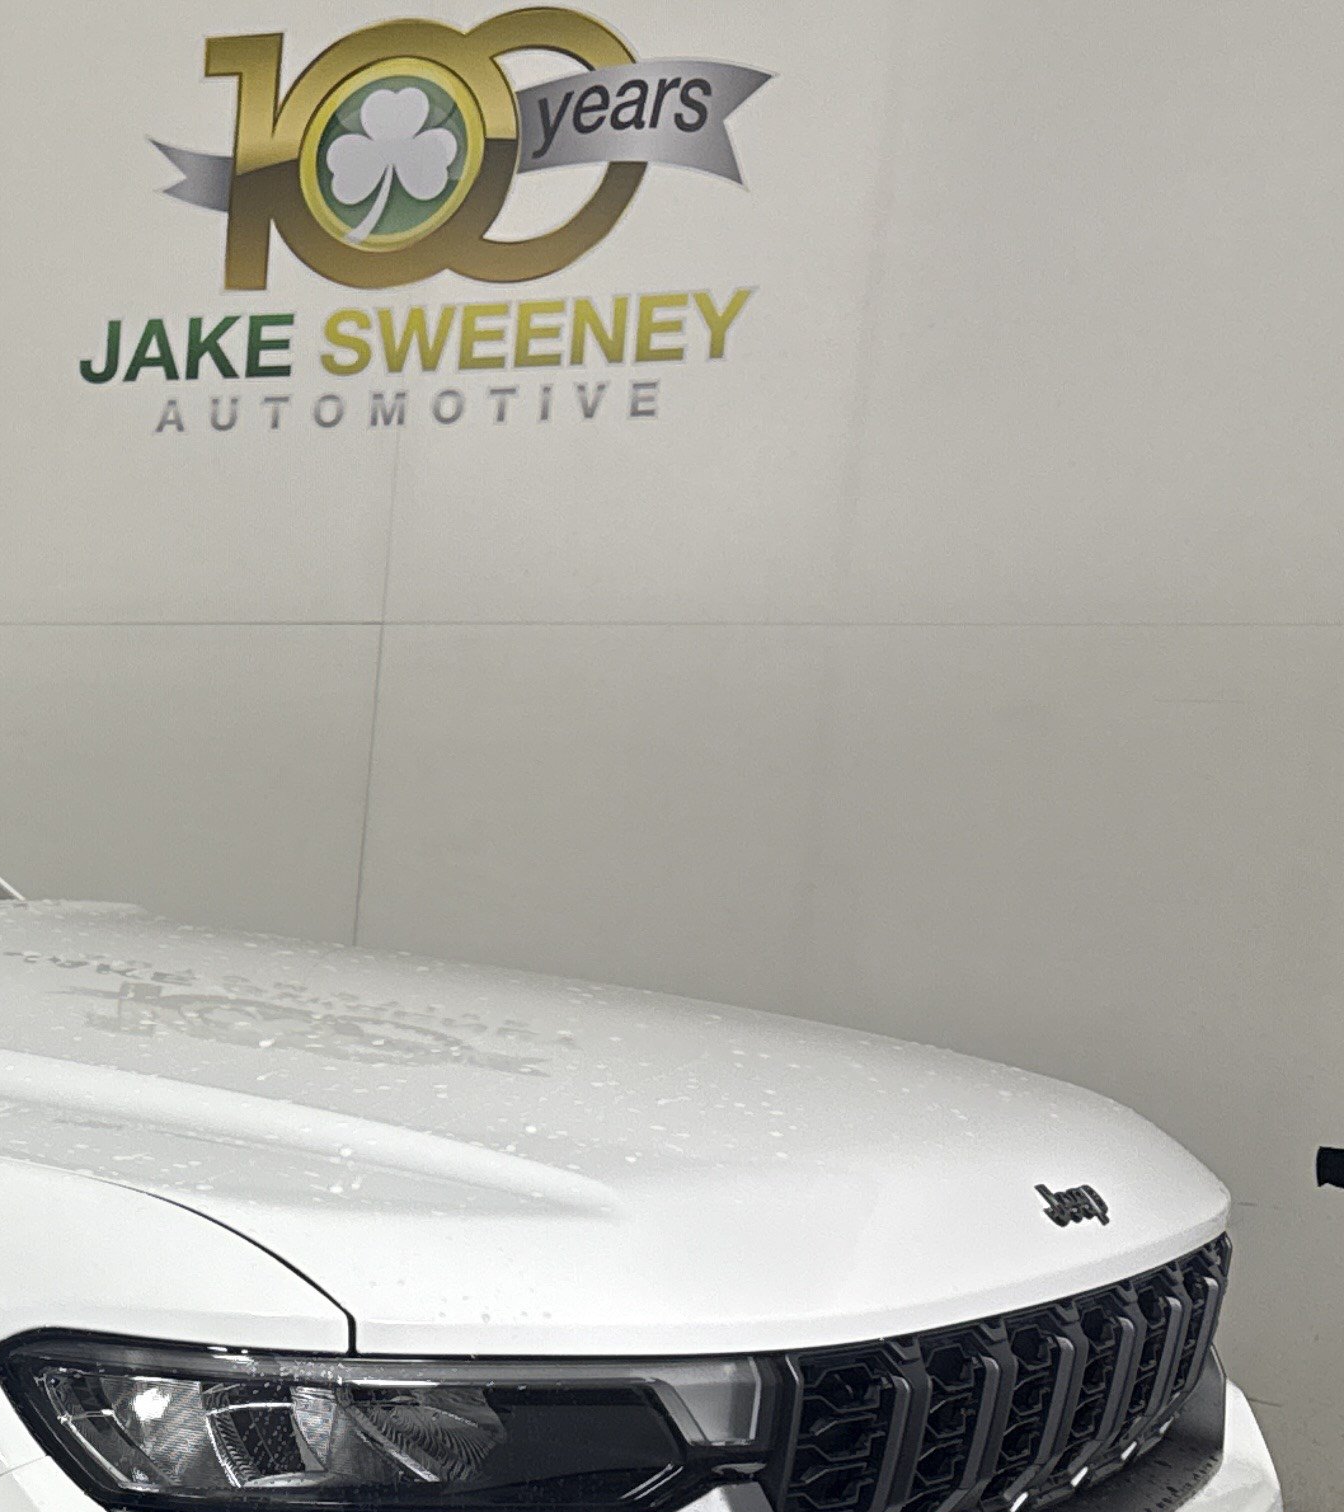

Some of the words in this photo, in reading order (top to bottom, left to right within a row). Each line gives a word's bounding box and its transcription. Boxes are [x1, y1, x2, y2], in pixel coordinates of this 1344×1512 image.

[204, 7, 650, 292] 100
[531, 74, 713, 158] years
[79, 312, 296, 384] JAKE
[320, 285, 756, 377] SWEENEY
[154, 380, 660, 433] AUTOMOTIVE
[1034, 1183, 1110, 1228] Jeep
